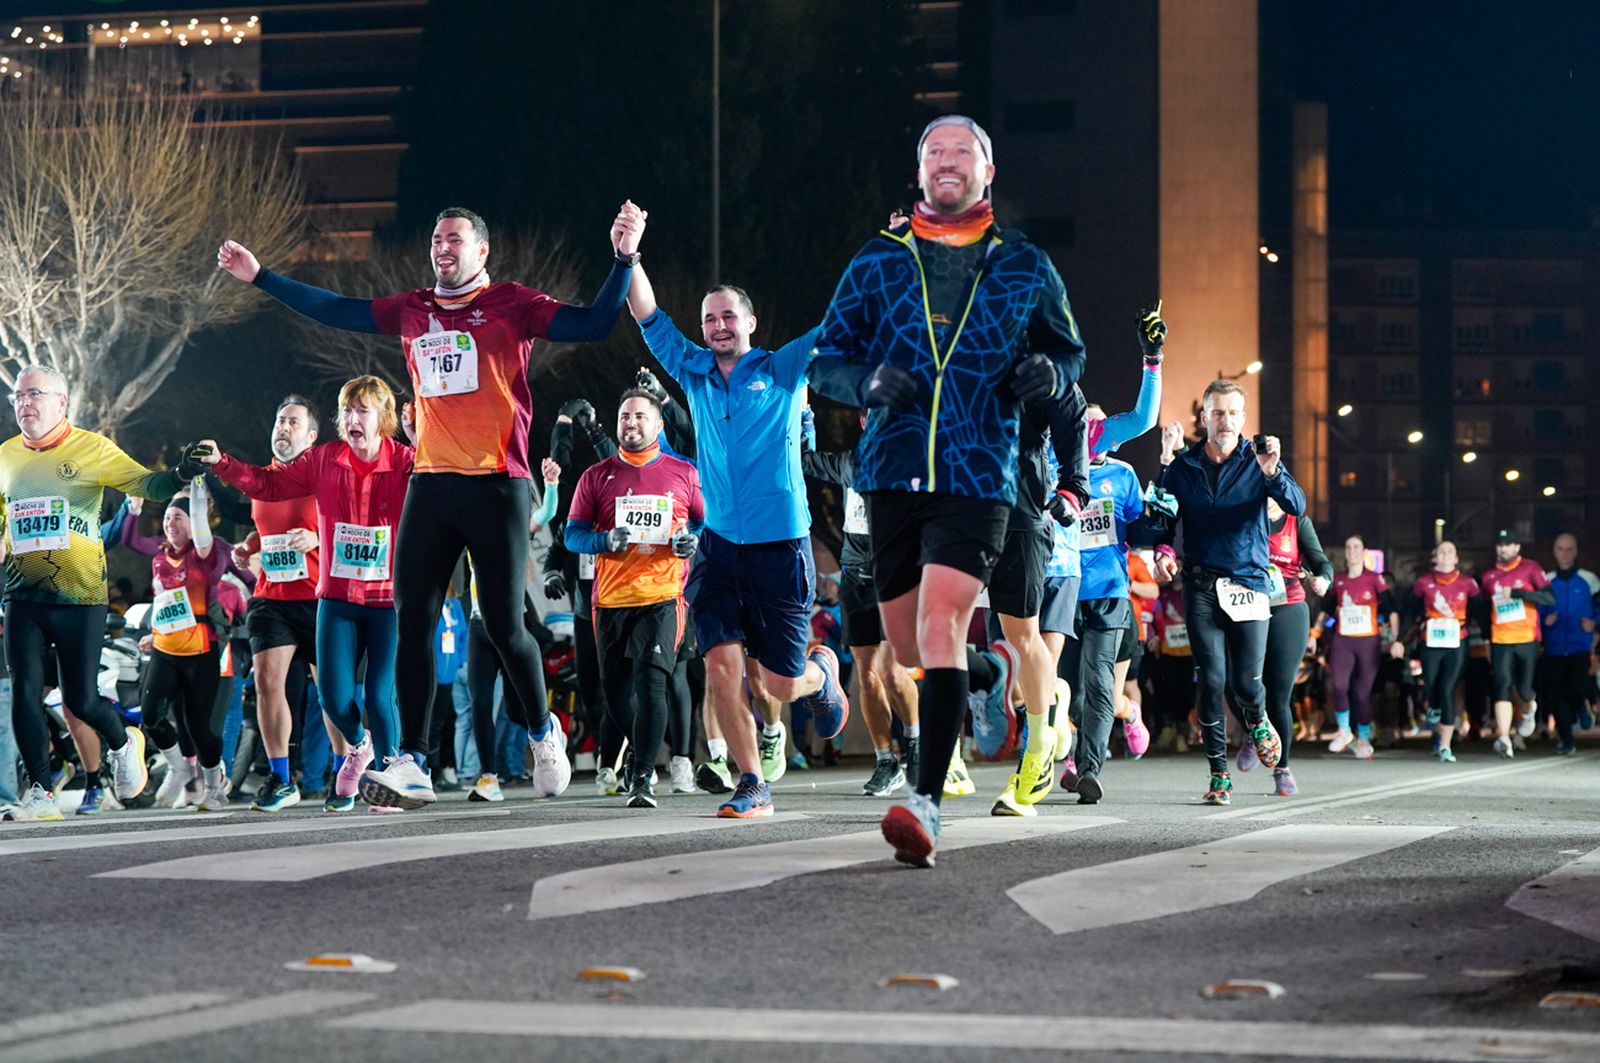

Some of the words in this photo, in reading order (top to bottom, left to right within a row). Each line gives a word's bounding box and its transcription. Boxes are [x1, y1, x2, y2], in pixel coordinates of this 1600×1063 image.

[16, 515, 60, 534] 13479
[625, 511, 662, 527] 4299
[1080, 515, 1111, 533] 2338
[347, 529, 363, 537] NOCHE
[344, 543, 379, 561] 8144
[157, 603, 187, 622] 3083
